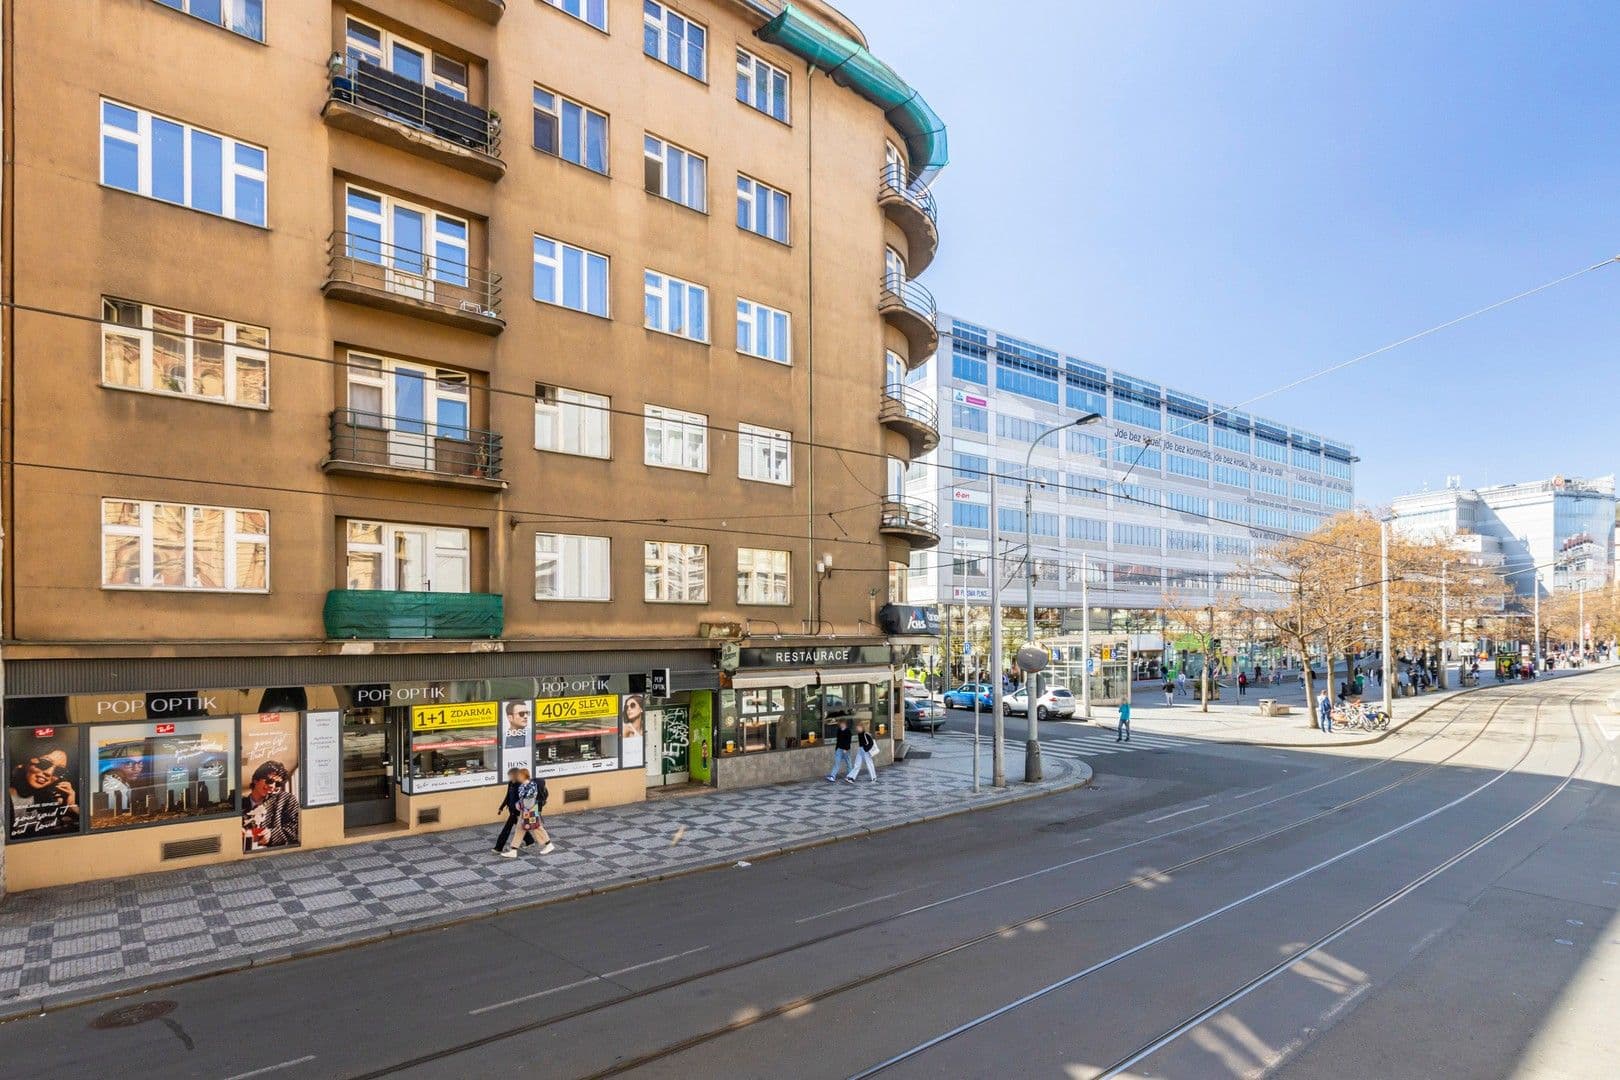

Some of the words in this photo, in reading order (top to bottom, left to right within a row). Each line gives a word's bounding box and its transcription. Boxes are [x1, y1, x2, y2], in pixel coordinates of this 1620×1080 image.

[775, 650, 849, 663] RESTAURACE
[357, 688, 392, 702] POP
[397, 686, 446, 700] OPTIK
[541, 682, 569, 693] POP
[571, 680, 609, 691] OPTIK
[97, 700, 144, 715] POP
[150, 696, 217, 713] OPTIK
[541, 701, 577, 719] 40%
[578, 698, 609, 709] SLEVA
[417, 709, 448, 727] 1+1
[450, 708, 492, 718] ZDARMA
[505, 728, 528, 737] BOSS
